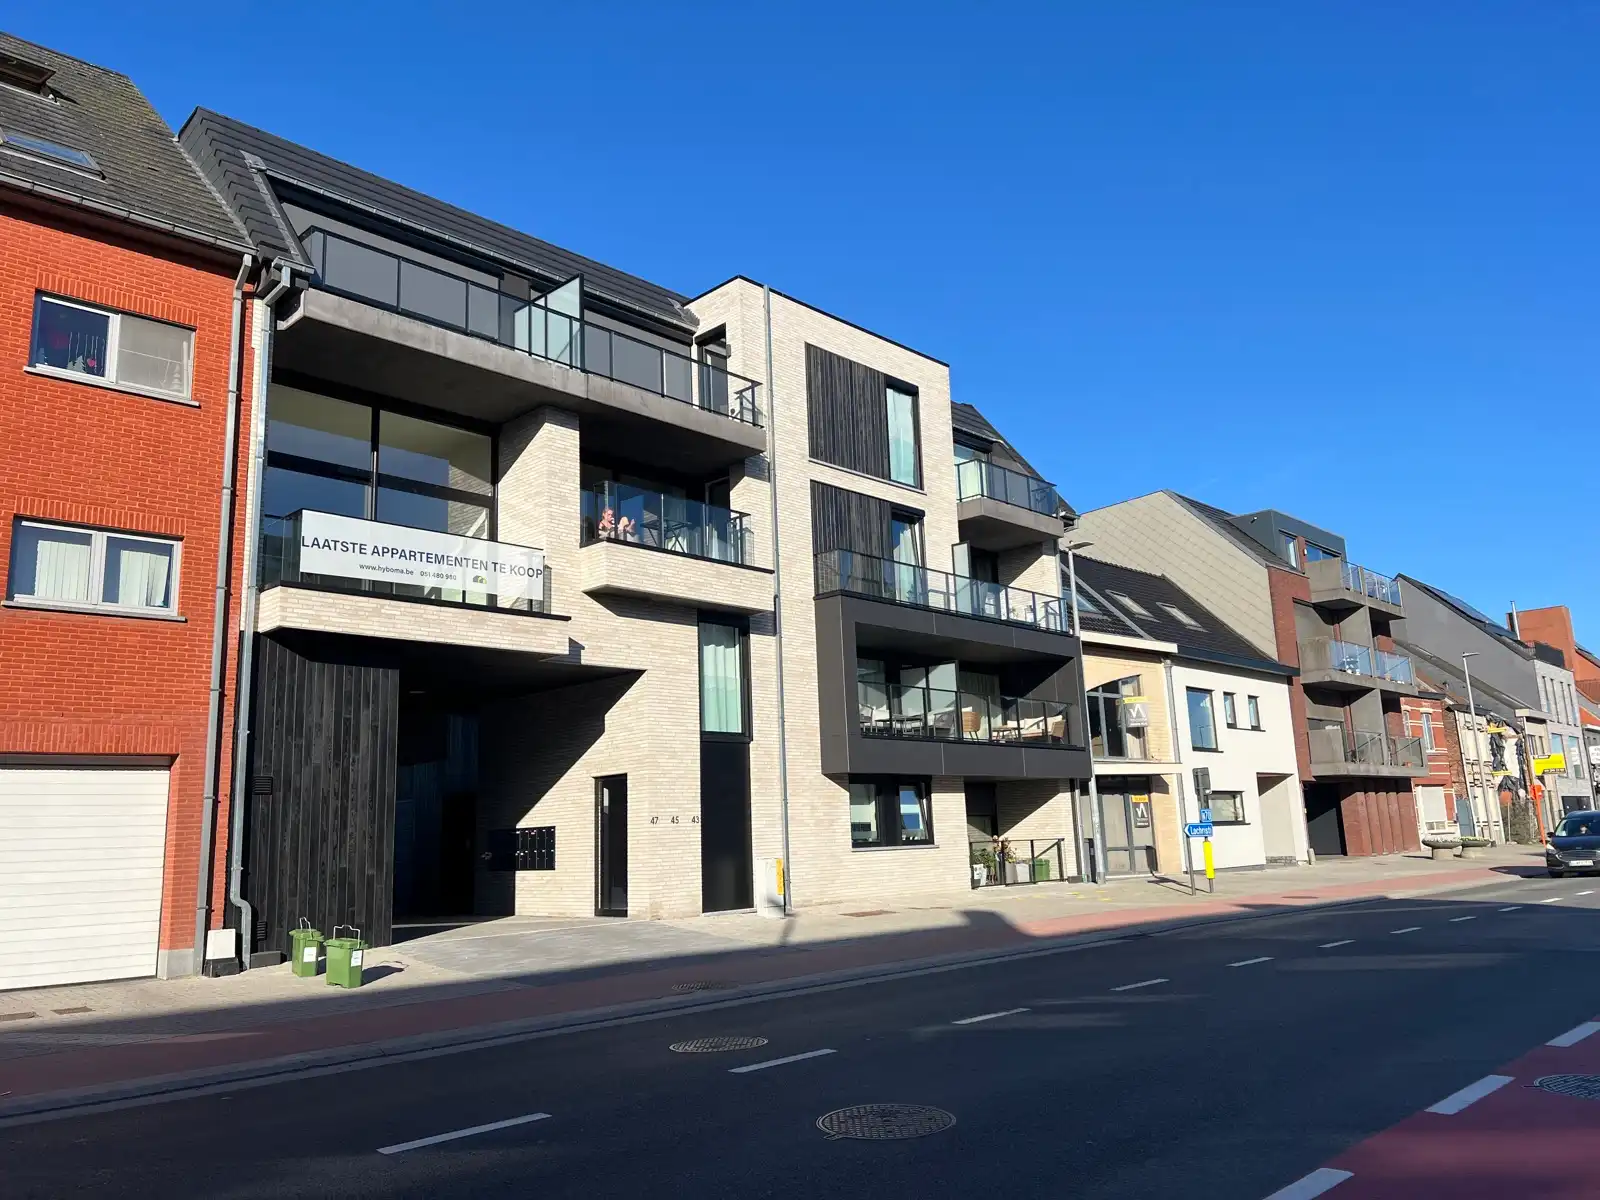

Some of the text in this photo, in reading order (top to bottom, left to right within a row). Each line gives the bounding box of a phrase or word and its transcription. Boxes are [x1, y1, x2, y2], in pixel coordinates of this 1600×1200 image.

[301, 535, 543, 578] LAATSTE APPARTEMENTEN TE KOOP
[359, 563, 414, 576] www.hyboma.be
[650, 815, 700, 825] 47 45 43
